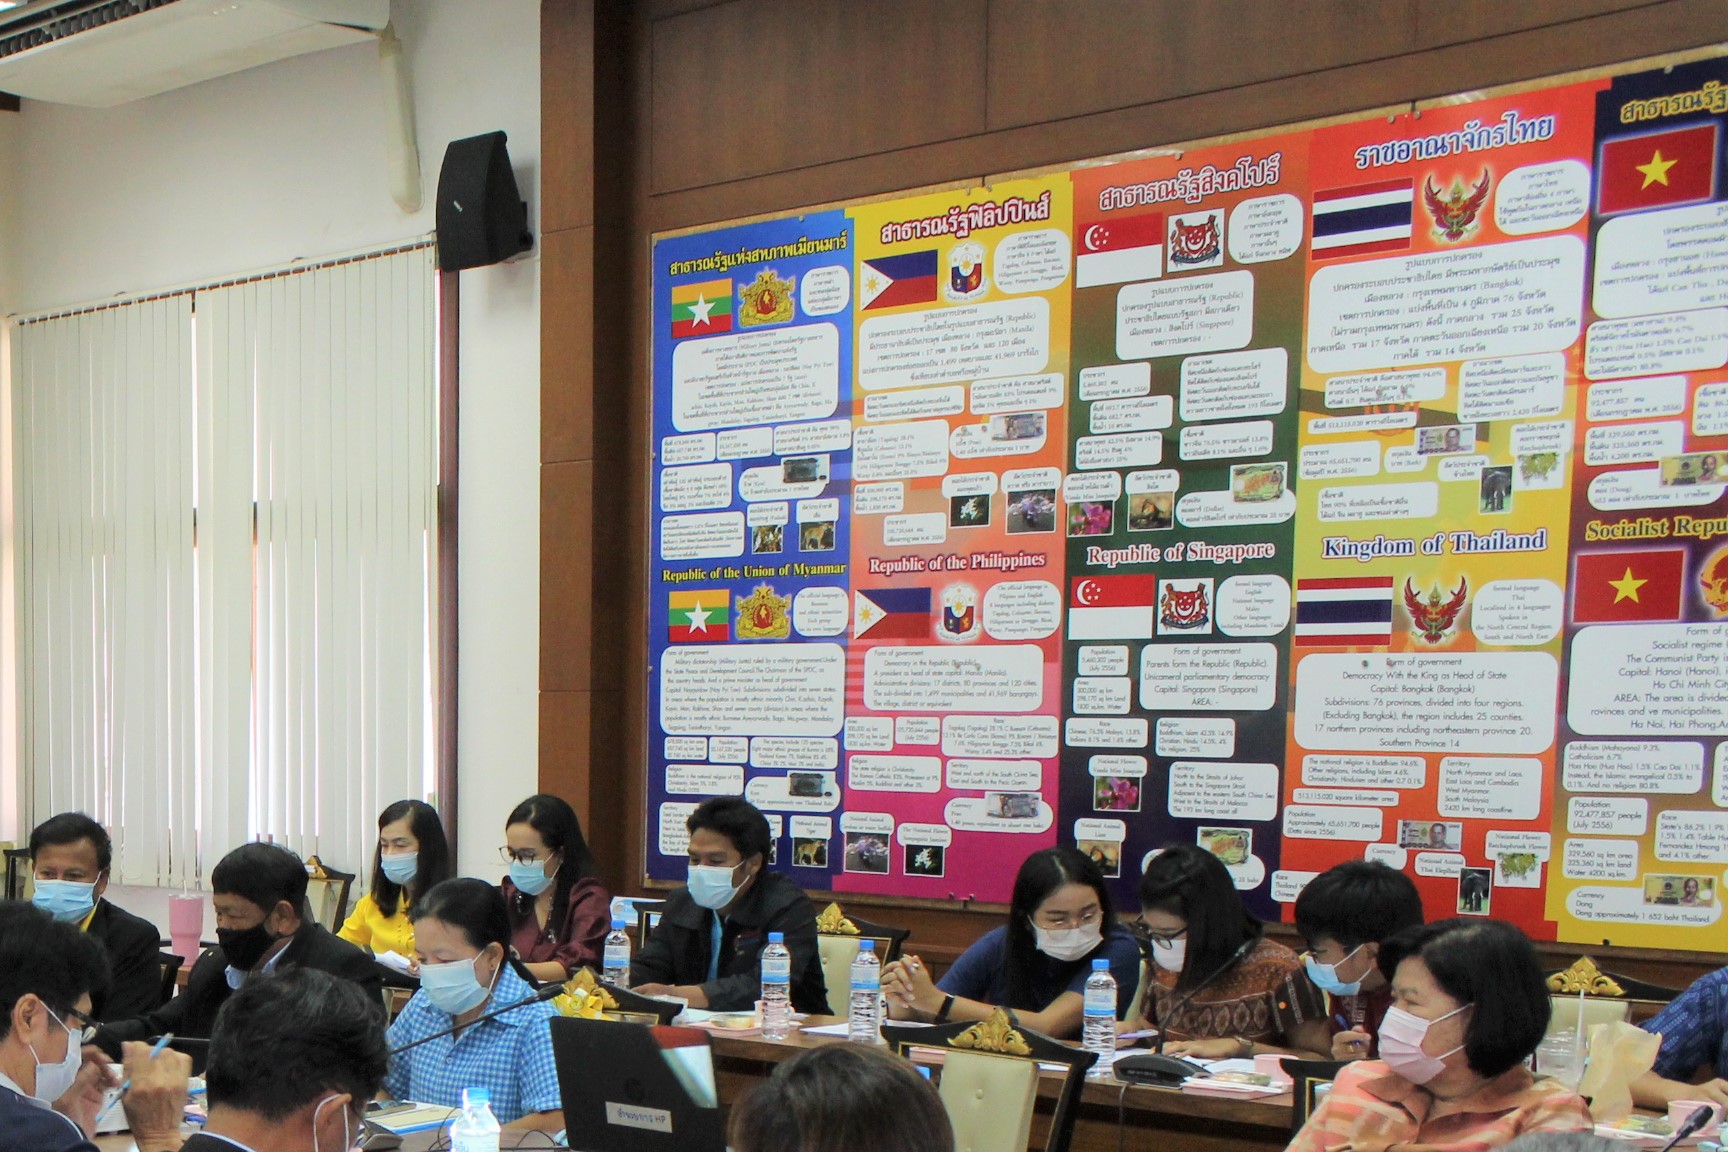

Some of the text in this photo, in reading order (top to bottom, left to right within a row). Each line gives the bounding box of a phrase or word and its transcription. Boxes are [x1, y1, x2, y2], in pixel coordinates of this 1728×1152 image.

[1355, 110, 1554, 169] ราชอาณาจักรไทย
[1100, 152, 1281, 210] สาธารณรัฐสิงคโปร์
[880, 189, 1051, 244] สาธารณรัฐฟิลิปปินส์
[669, 229, 848, 275] สาธารณรัฐแห่งสหภาพเมียนมาร์
[1405, 252, 1483, 271] รูปแบบการปกครอง
[1333, 270, 1442, 292] ปกครองระบอบประชาธิปไตย
[1364, 277, 1523, 303] เมืองหลวง กรุงเทพมหานคร (Bangkok)
[1339, 307, 1399, 321] เขตการปกครอง
[1470, 296, 1500, 309] ภูมิภาค
[1503, 294, 1514, 303] 76
[1518, 289, 1546, 301] จังหวัด
[1426, 313, 1443, 326] ดังนี้
[1445, 314, 1484, 325] ภาคกลาง
[1491, 311, 1508, 320] รวม
[1511, 309, 1522, 318] 25
[1525, 303, 1554, 316] จังหวัด
[1310, 317, 1576, 354] ภาคเหนือ รวม 17 จังหวัด ภาคตะวันออกเฉียงเหนือ รวม 20 จังหวัด
[1393, 342, 1486, 360] ภาคใต้ รวม 14 จังหวัด
[1585, 518, 1669, 541] Socialist
[1322, 528, 1547, 562] Kingdom of Thailand
[1086, 541, 1275, 568] Republic of Singapore
[869, 550, 1047, 576] Republic of the Philippines
[662, 563, 846, 583] Republic of the Union of Myanmar
[1686, 625, 1722, 635] Form of
[1173, 646, 1241, 657] Form of government
[1652, 641, 1722, 651] Socialist regime
[1407, 656, 1416, 666] of
[1417, 659, 1462, 668] government
[1626, 653, 1719, 664] The Communist Party
[1146, 660, 1169, 668] Parents
[1172, 660, 1188, 668] form
[1189, 660, 1200, 668] the
[1202, 660, 1230, 669] Republic
[1144, 672, 1270, 682] Unicameral parliamentary democracy
[1342, 671, 1383, 681] Democracy
[1386, 671, 1404, 679] With
[1406, 671, 1418, 679] the
[1420, 671, 1439, 681] King
[1453, 670, 1473, 679] Head
[1476, 670, 1486, 679] of
[1487, 671, 1507, 679] State
[1618, 666, 1651, 678] Capital:
[1655, 667, 1682, 676] Hanoi
[1370, 684, 1475, 695] Capital: Bangkok (Bangkok)
[1653, 680, 1665, 689] Ho
[1669, 680, 1684, 689] Chi
[1687, 679, 1711, 689] Minh
[1182, 685, 1216, 695] Singapore
[1218, 685, 1258, 695] (Singapore)
[1373, 698, 1383, 706] 76
[1425, 697, 1454, 707] divided
[1456, 698, 1471, 707] into
[1474, 697, 1489, 707] four
[1645, 694, 1660, 702] The
[1687, 693, 1694, 702] is
[1323, 710, 1360, 721] (Excluding
[1401, 711, 1413, 720] the
[1415, 712, 1440, 722] region
[1443, 711, 1474, 721] includes
[1476, 712, 1488, 721] 25
[1590, 707, 1624, 716] rovinces
[1628, 706, 1645, 716] and
[1314, 724, 1324, 732] 17
[1326, 724, 1357, 733] northern
[1359, 725, 1393, 734] provinces
[1396, 725, 1430, 736] including
[1433, 725, 1480, 734] northeastern
[1482, 727, 1516, 736] province
[1630, 720, 1643, 729] Ha
[1669, 720, 1684, 729] Hai
[1379, 738, 1460, 748] Southern Province 14
[1574, 800, 1611, 810] Population
[1617, 812, 1642, 821] people
[1573, 820, 1613, 830] (July 2556)
[1576, 891, 1605, 900] Currency
[1576, 900, 1593, 909] Dong
